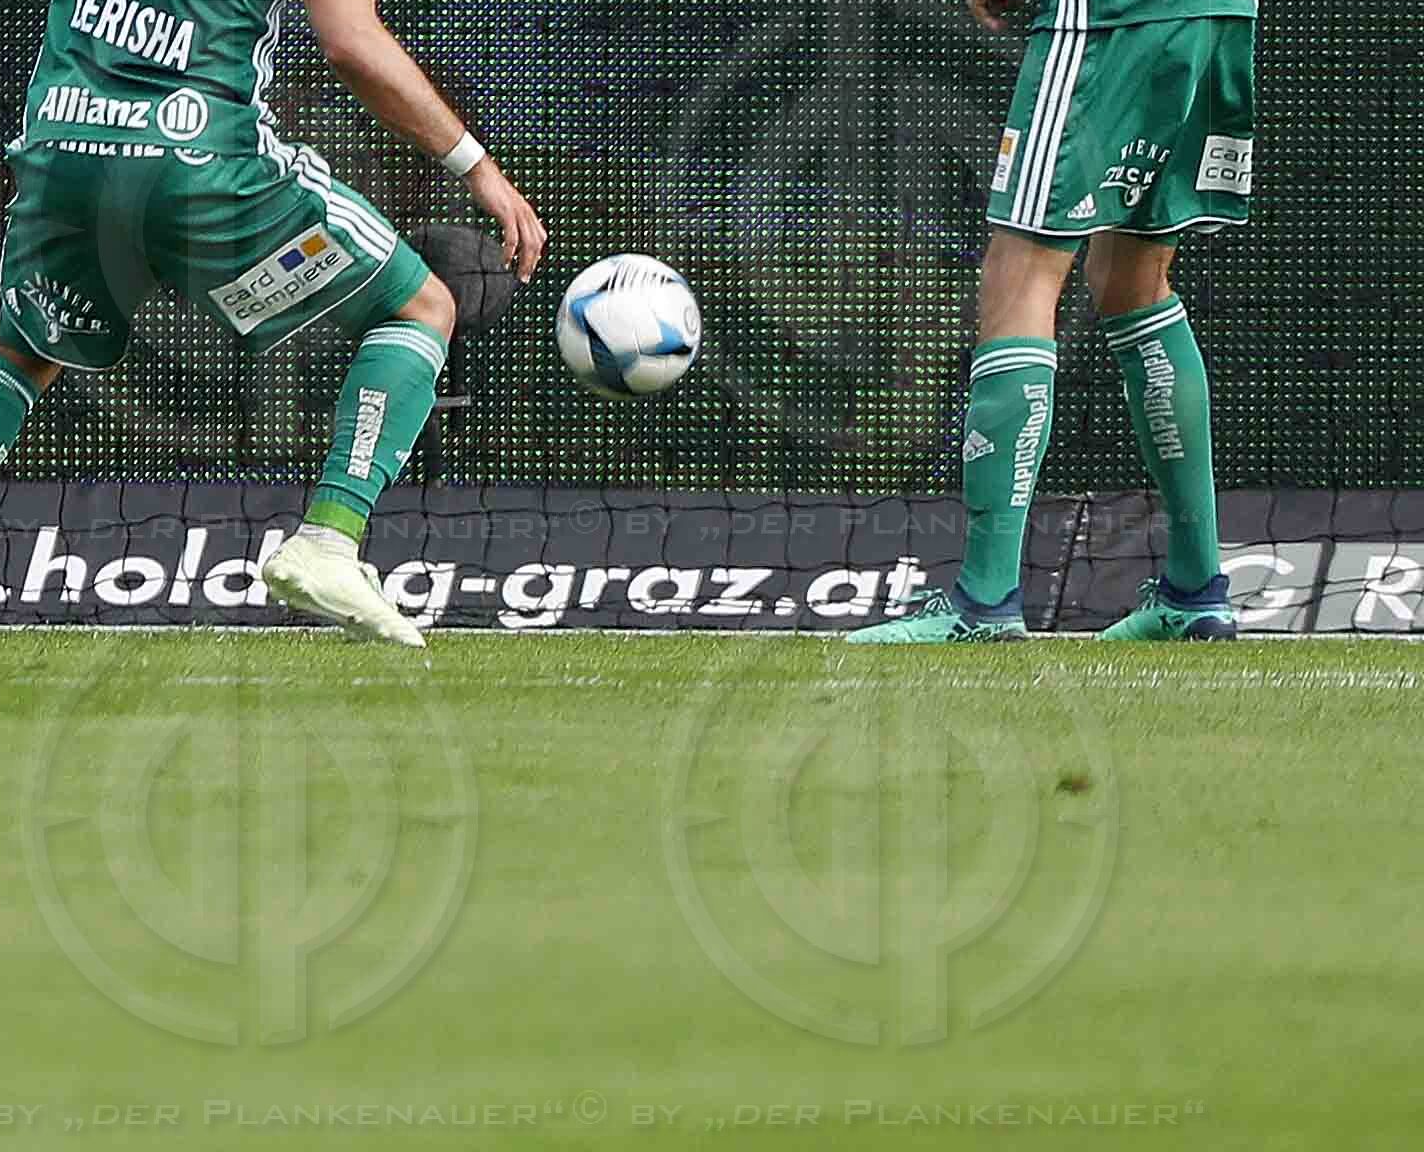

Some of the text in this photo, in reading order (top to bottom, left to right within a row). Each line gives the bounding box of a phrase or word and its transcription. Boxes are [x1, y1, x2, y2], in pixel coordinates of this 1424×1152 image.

[37, 86, 152, 129] Allianz
[223, 271, 276, 308] card
[234, 251, 343, 321] complete
